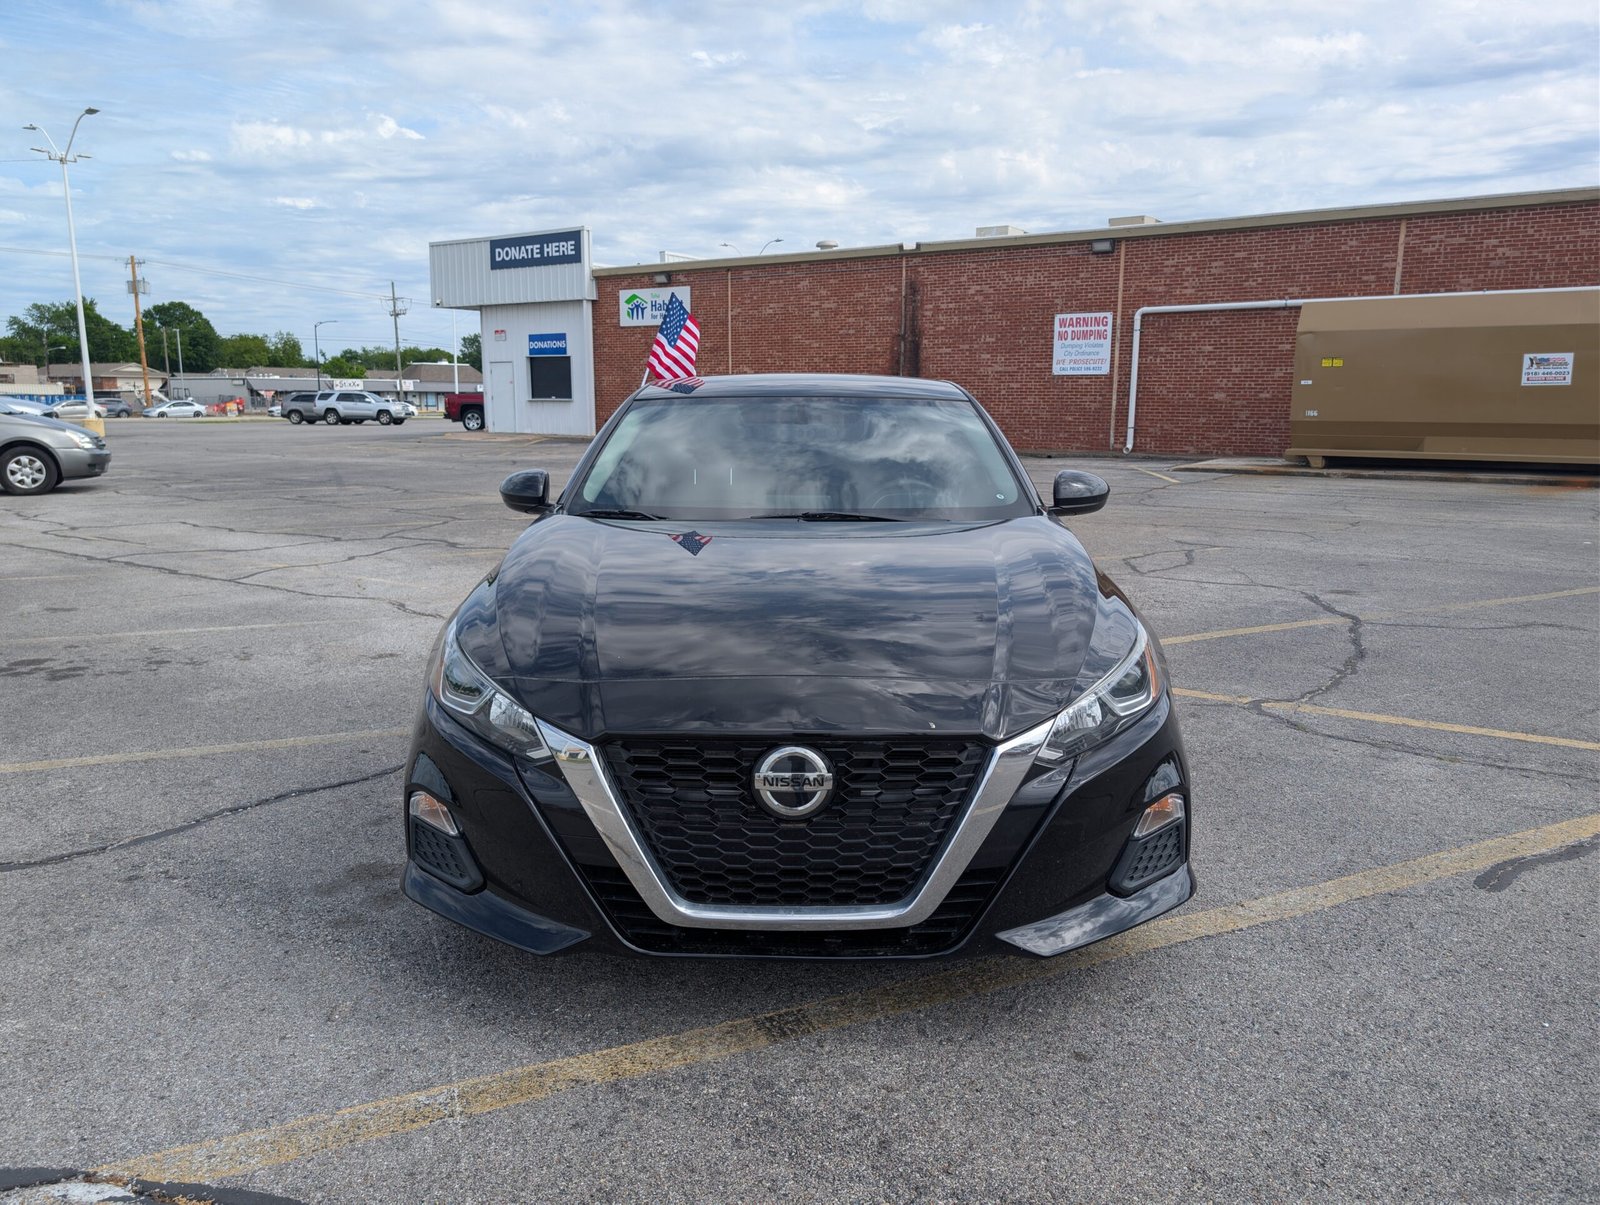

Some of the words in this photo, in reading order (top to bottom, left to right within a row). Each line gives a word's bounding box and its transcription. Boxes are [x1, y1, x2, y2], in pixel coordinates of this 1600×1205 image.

[495, 244, 541, 262] DONATE
[544, 240, 576, 257] HERE
[1058, 316, 1109, 329] WARNING
[1058, 330, 1068, 341] NO
[1070, 329, 1108, 341] DUMPING
[529, 340, 566, 349] DONATIONS
[762, 777, 825, 788] NISSAN
